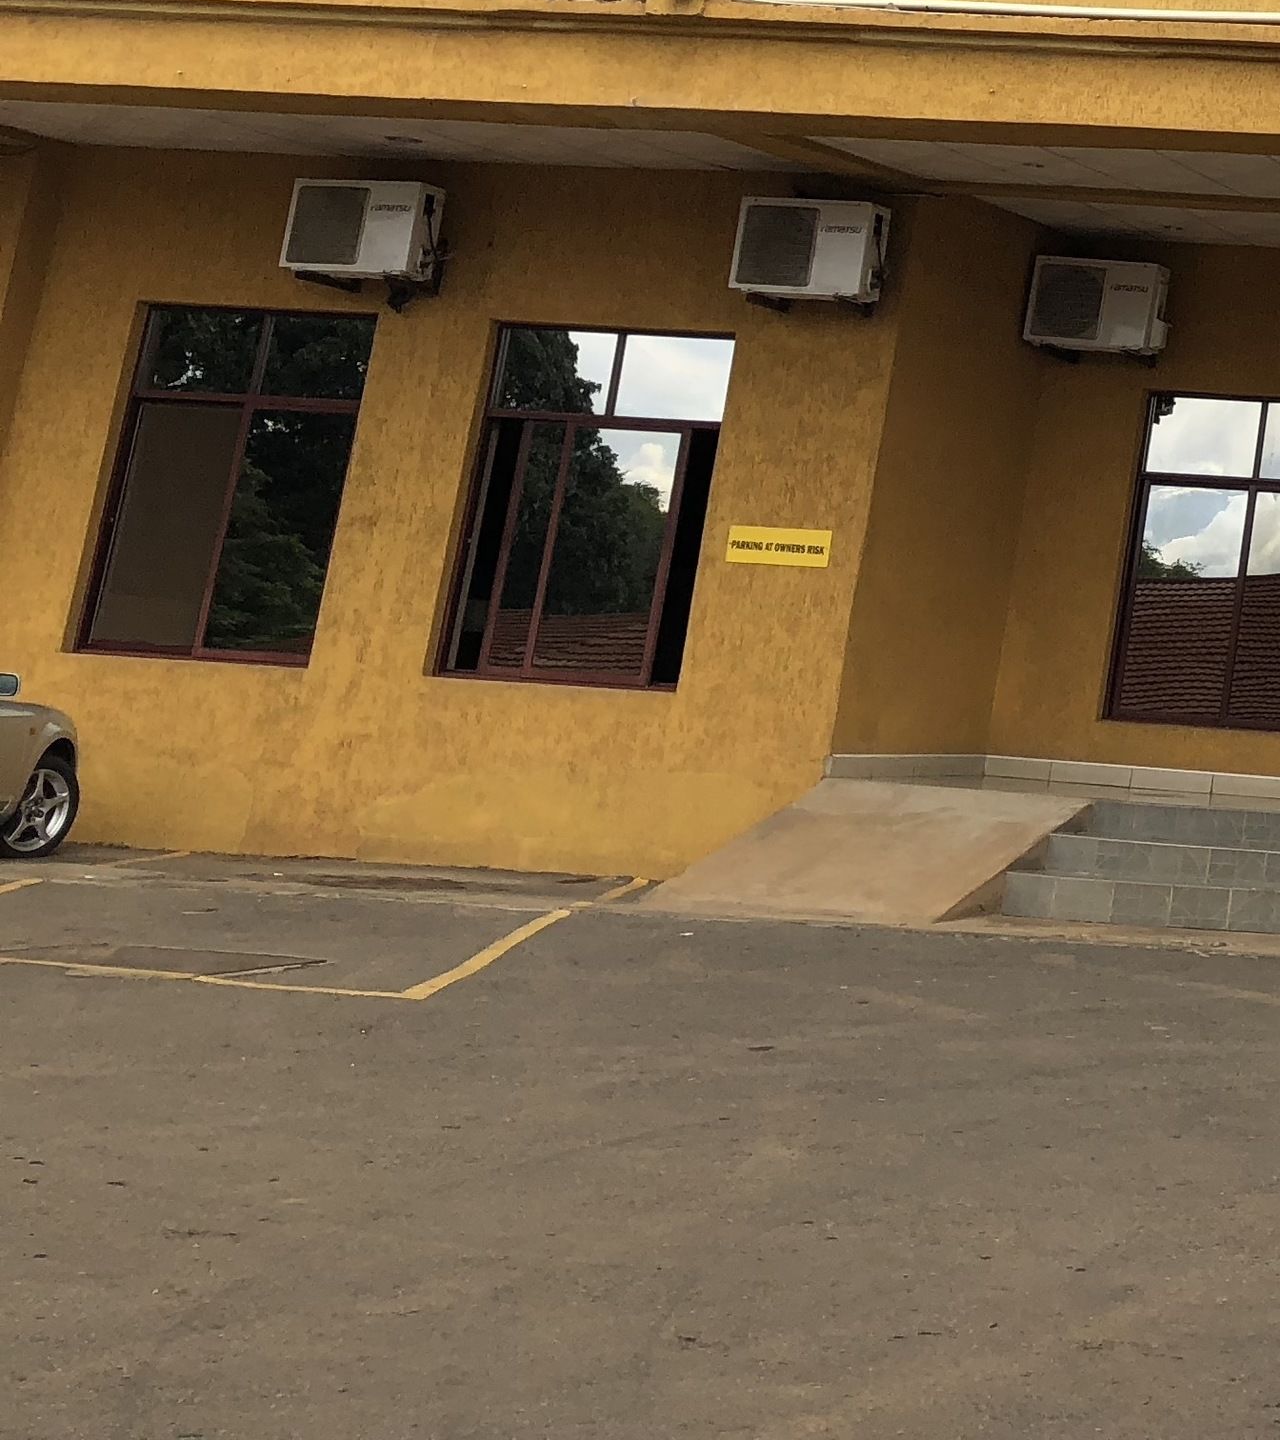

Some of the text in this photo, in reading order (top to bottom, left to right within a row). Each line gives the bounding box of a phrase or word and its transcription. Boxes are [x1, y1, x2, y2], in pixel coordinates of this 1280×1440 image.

[731, 540, 825, 555] PARKING AT OWNERS RISK
